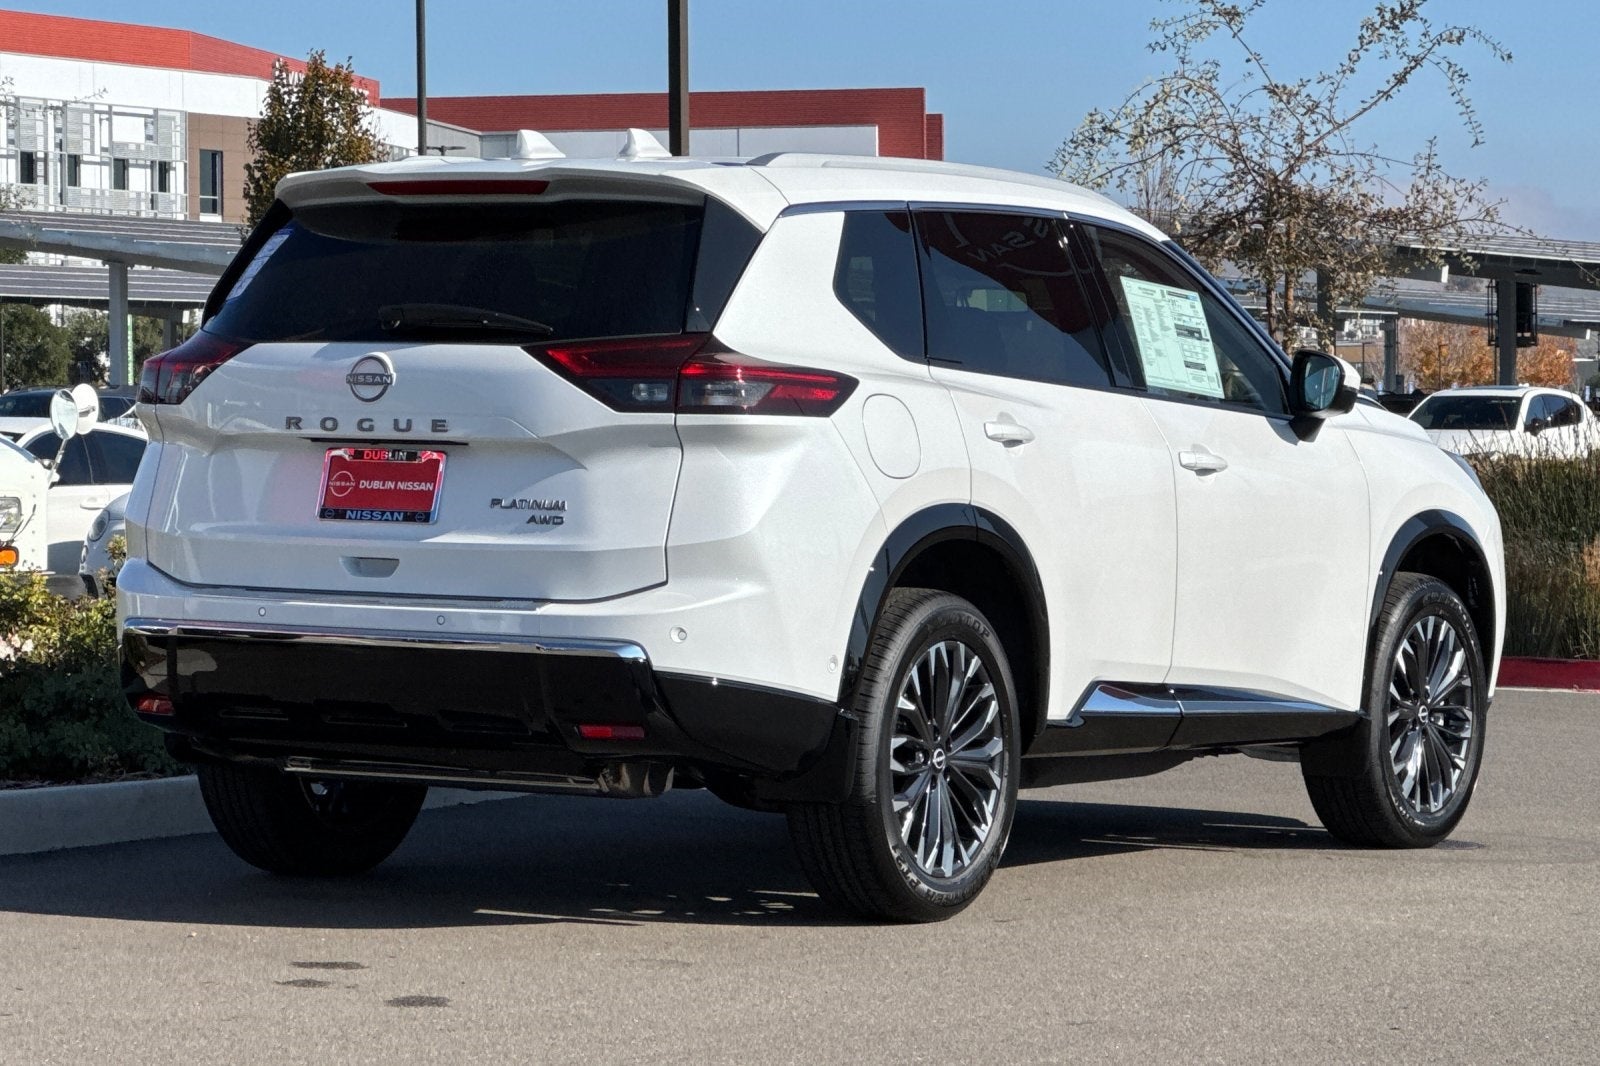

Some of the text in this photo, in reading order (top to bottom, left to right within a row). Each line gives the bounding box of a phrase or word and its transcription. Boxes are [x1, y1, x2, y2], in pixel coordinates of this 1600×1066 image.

[346, 374, 391, 384] NISSAN
[285, 416, 449, 432] ROGUE
[364, 450, 407, 461] DUBLIN
[359, 480, 434, 492] DUBLIN NISSAN
[490, 498, 567, 511] PLATINUM
[345, 510, 404, 521] NISSAN
[526, 515, 565, 525] AWD
